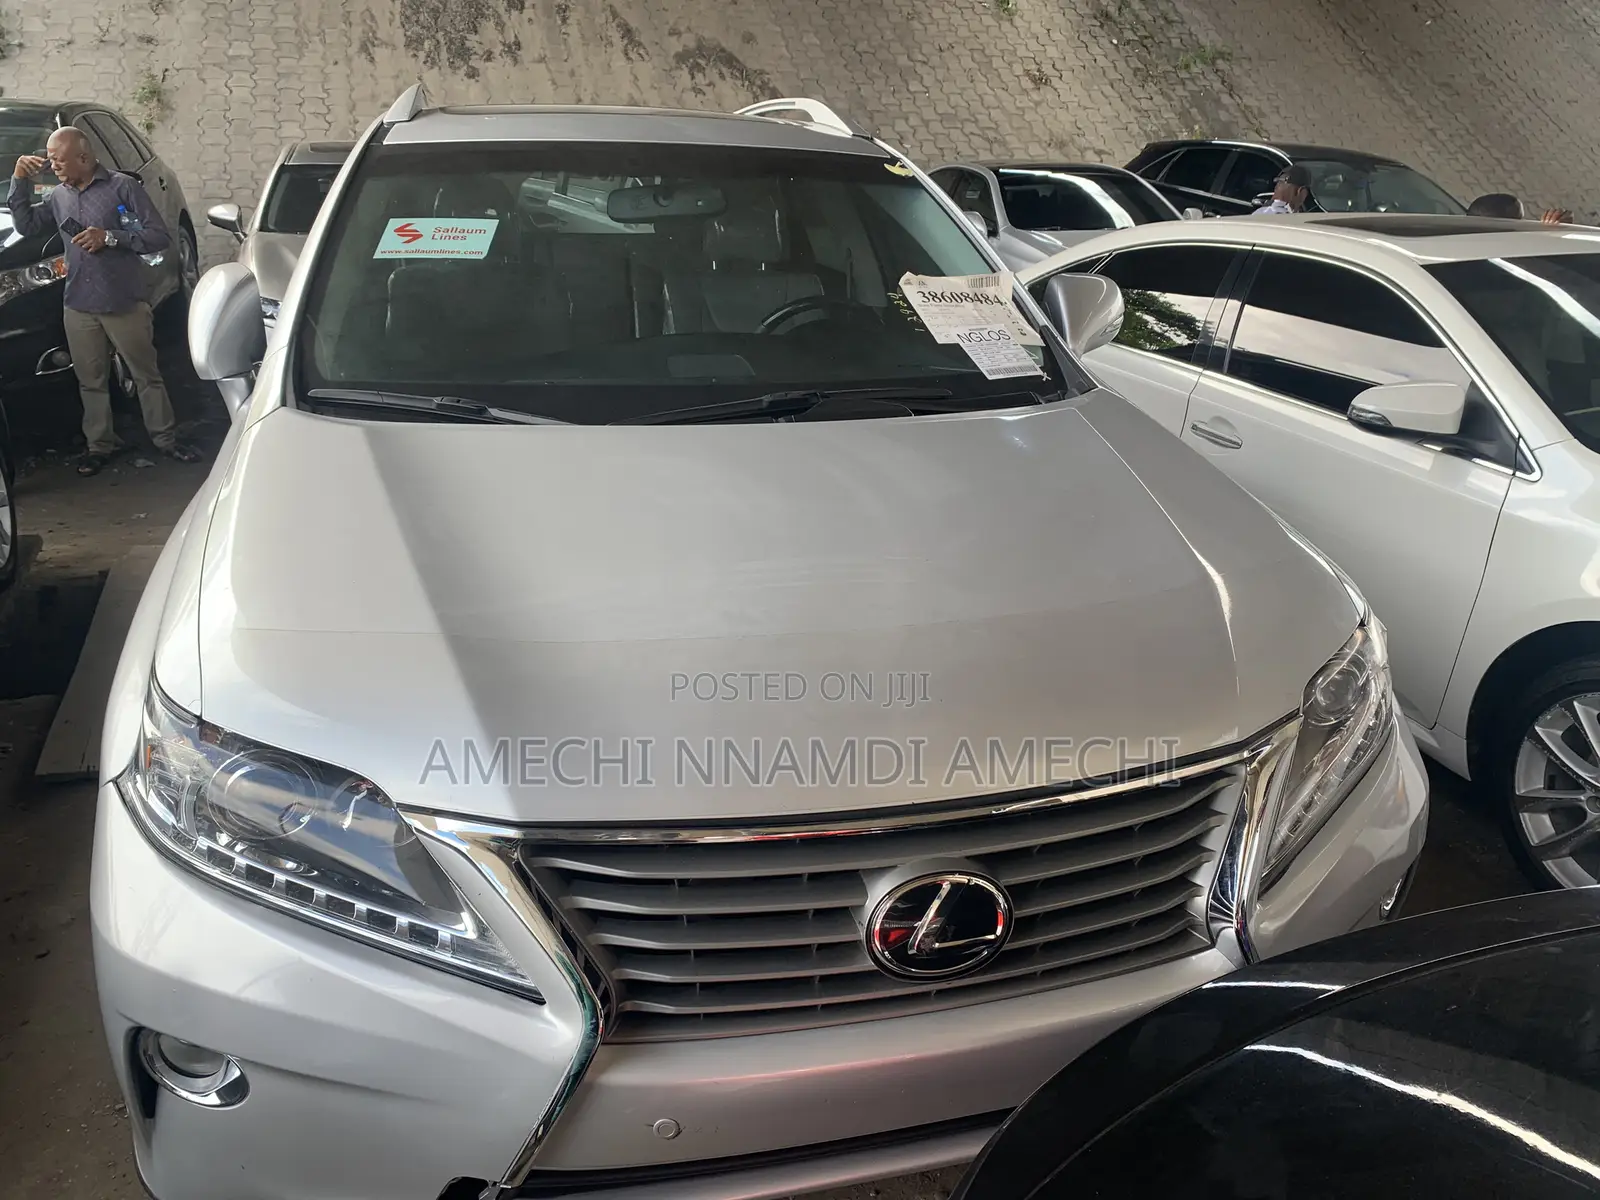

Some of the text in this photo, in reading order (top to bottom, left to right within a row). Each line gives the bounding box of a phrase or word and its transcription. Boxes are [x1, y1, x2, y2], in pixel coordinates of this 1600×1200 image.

[432, 226, 487, 234] Sallaum
[431, 233, 467, 241] Lines
[917, 290, 1004, 306] 38608484
[957, 329, 1011, 344] NGLOS
